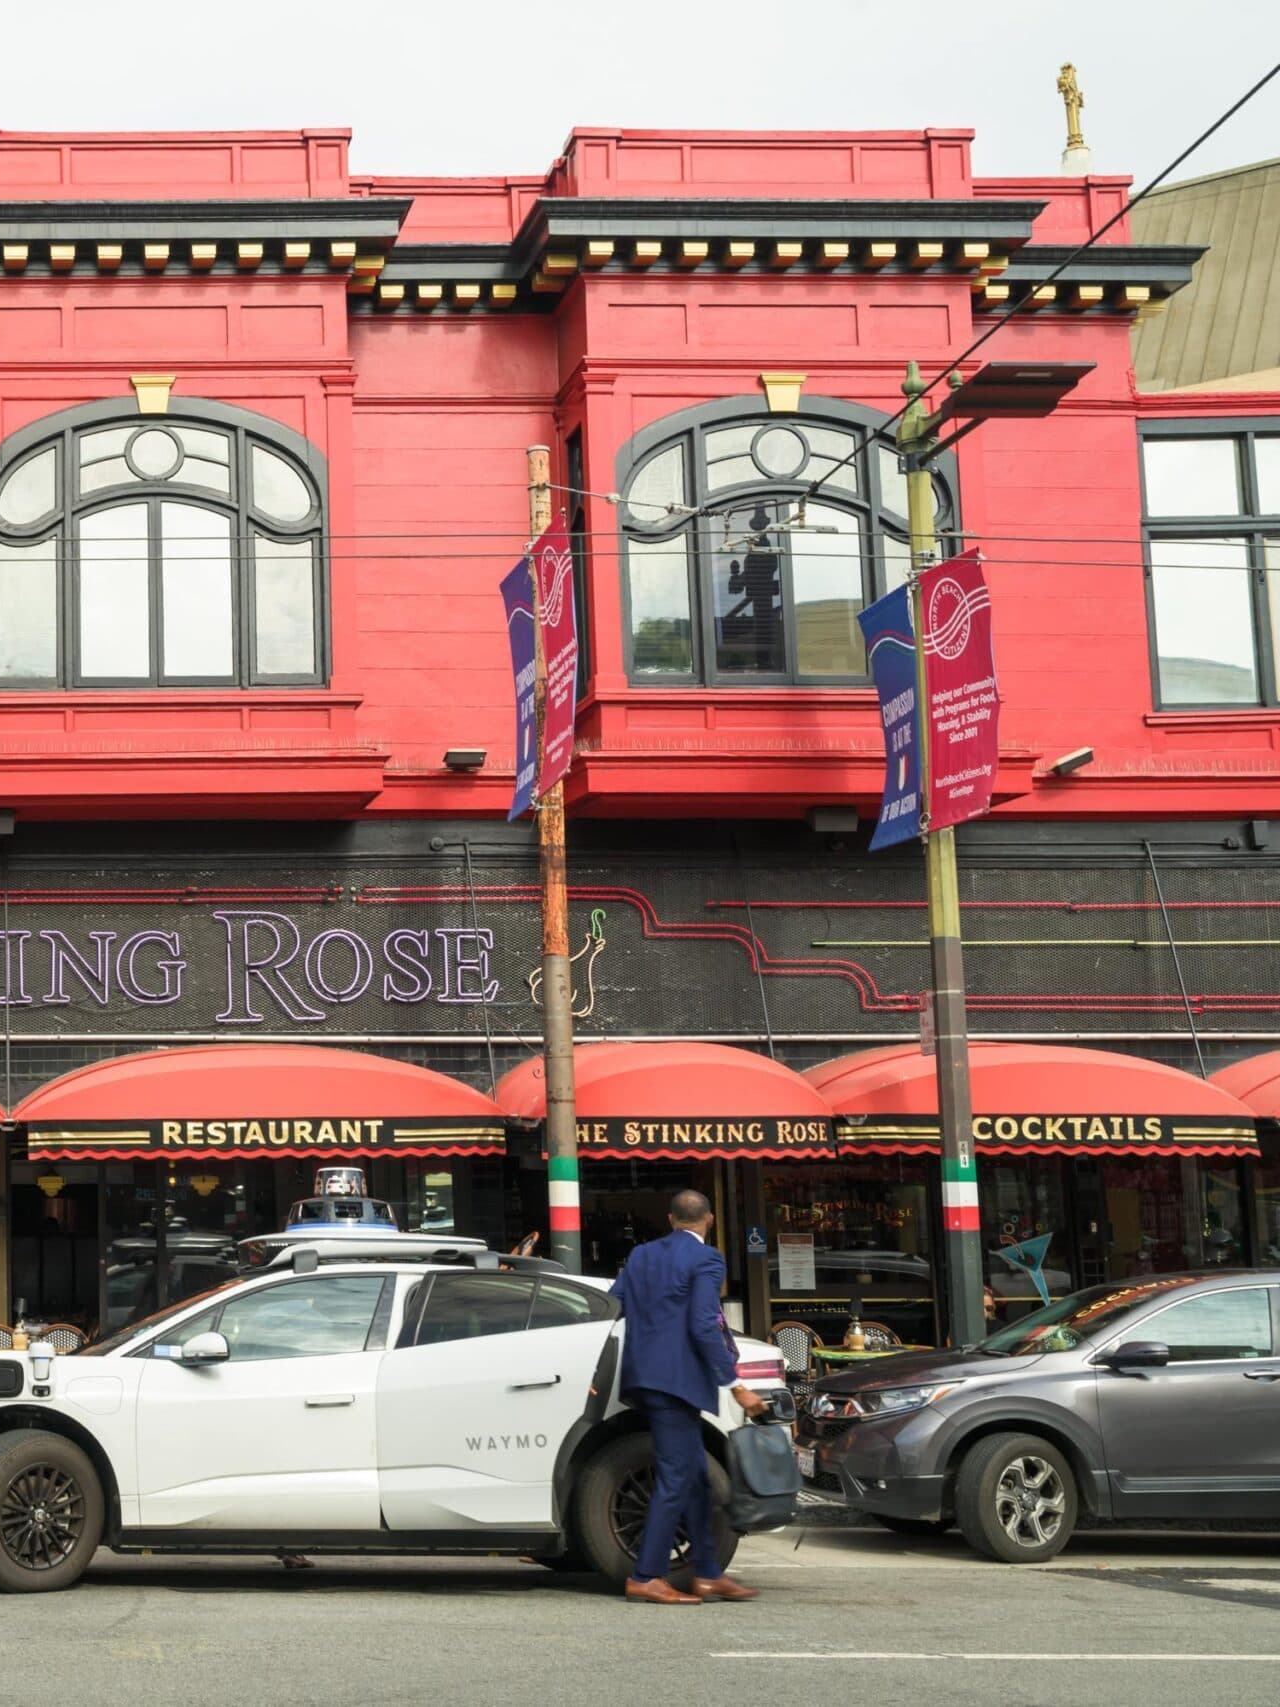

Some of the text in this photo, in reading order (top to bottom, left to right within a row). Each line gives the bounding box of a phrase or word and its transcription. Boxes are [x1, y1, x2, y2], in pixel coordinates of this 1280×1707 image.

[963, 676, 995, 694] Community
[882, 688, 914, 727] COMPASSION
[970, 695, 979, 707] for
[948, 731, 964, 744] Since
[162, 1119, 385, 1145] RESTAURANT
[576, 1123, 608, 1143] HE
[971, 1116, 1163, 1141] COCKTAILS
[465, 1433, 548, 1451] WAYMO
